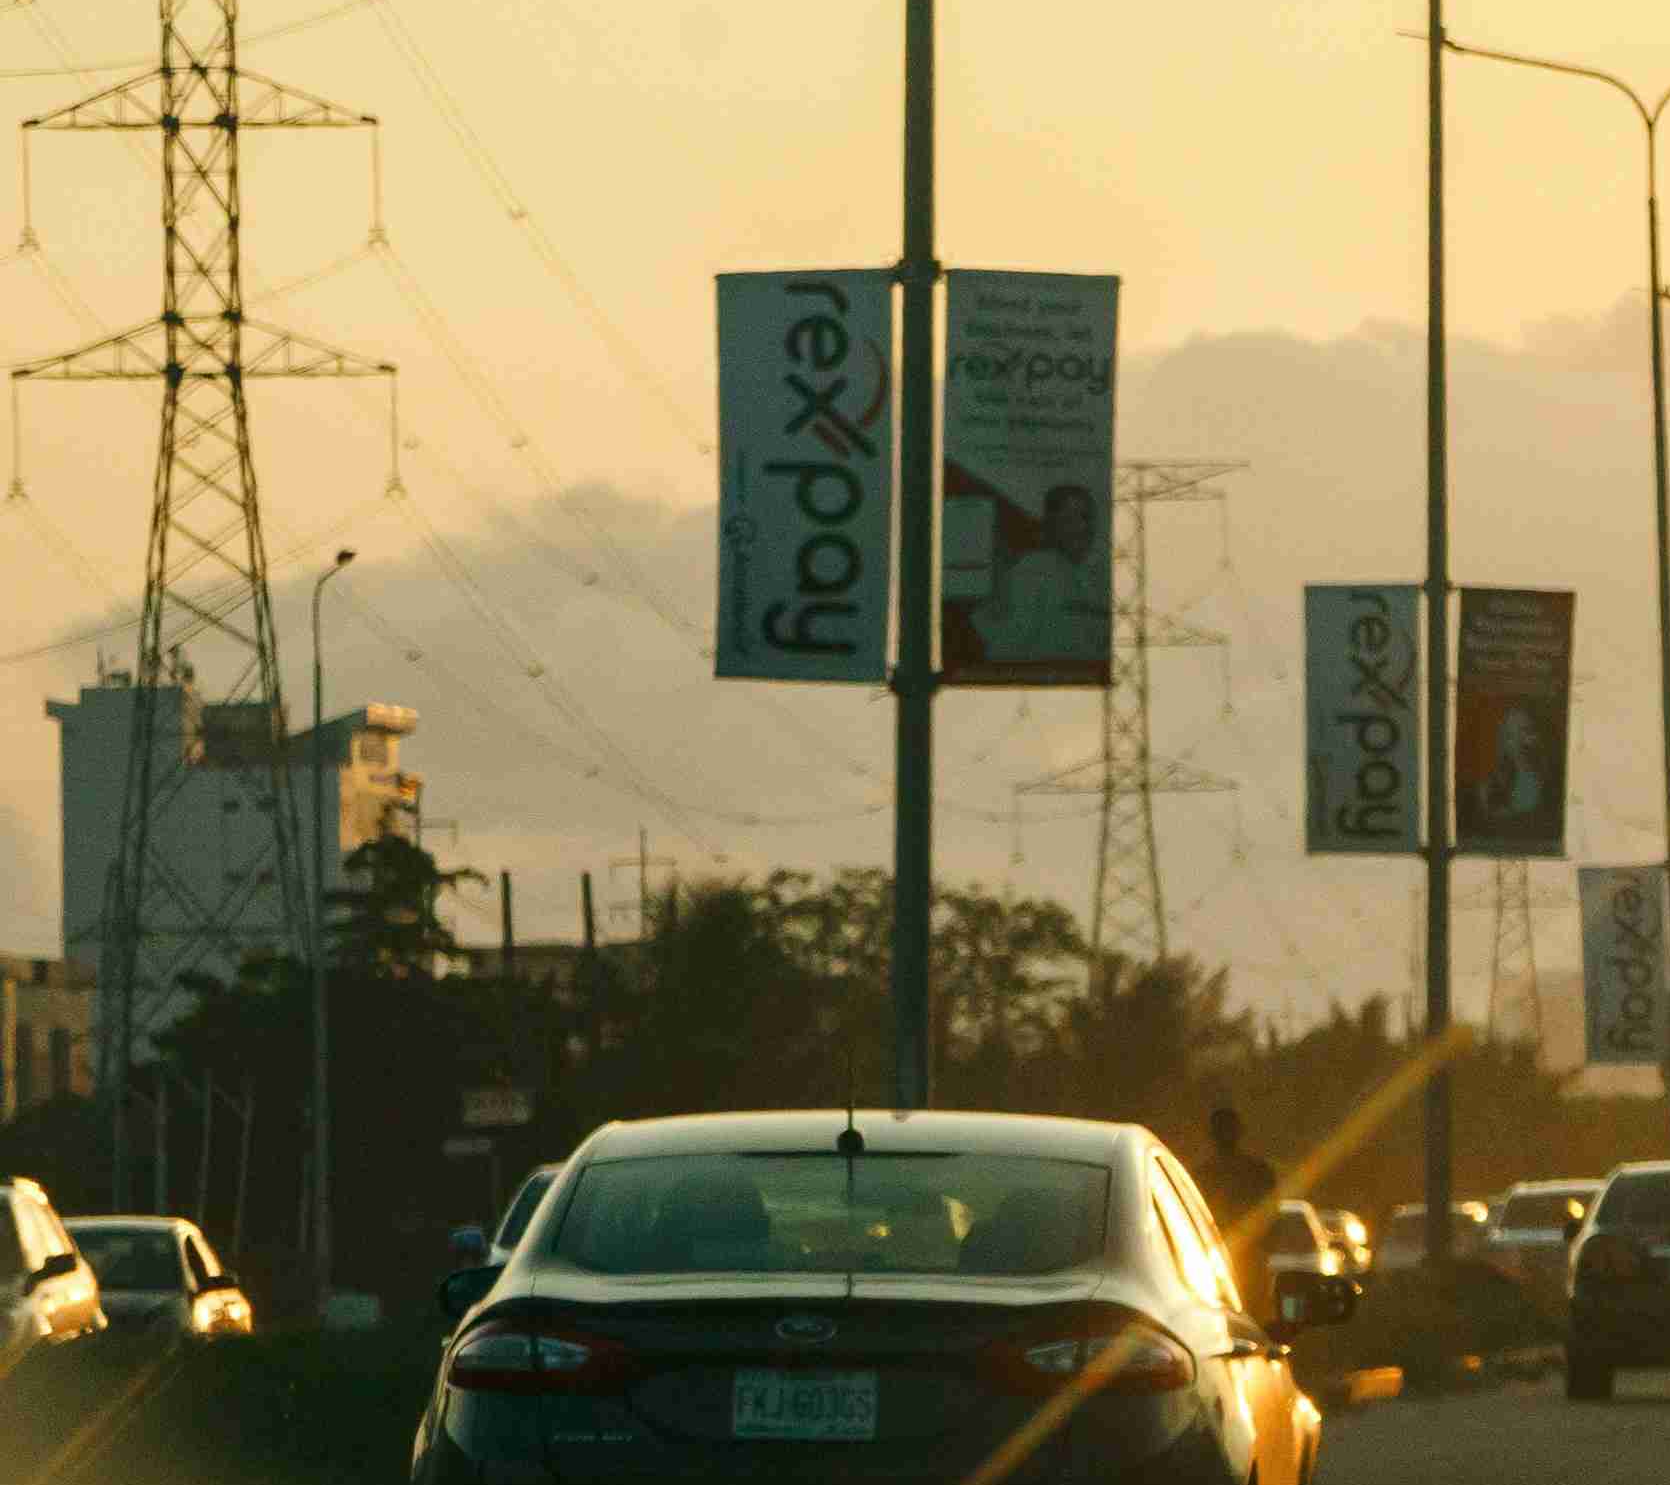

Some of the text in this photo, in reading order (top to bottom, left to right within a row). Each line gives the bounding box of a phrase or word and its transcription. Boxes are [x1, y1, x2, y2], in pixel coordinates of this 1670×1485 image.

[761, 279, 882, 657] rexpay
[950, 348, 1111, 396] rexpay
[1337, 590, 1410, 840] rexpay
[1607, 869, 1658, 1052] rexpay
